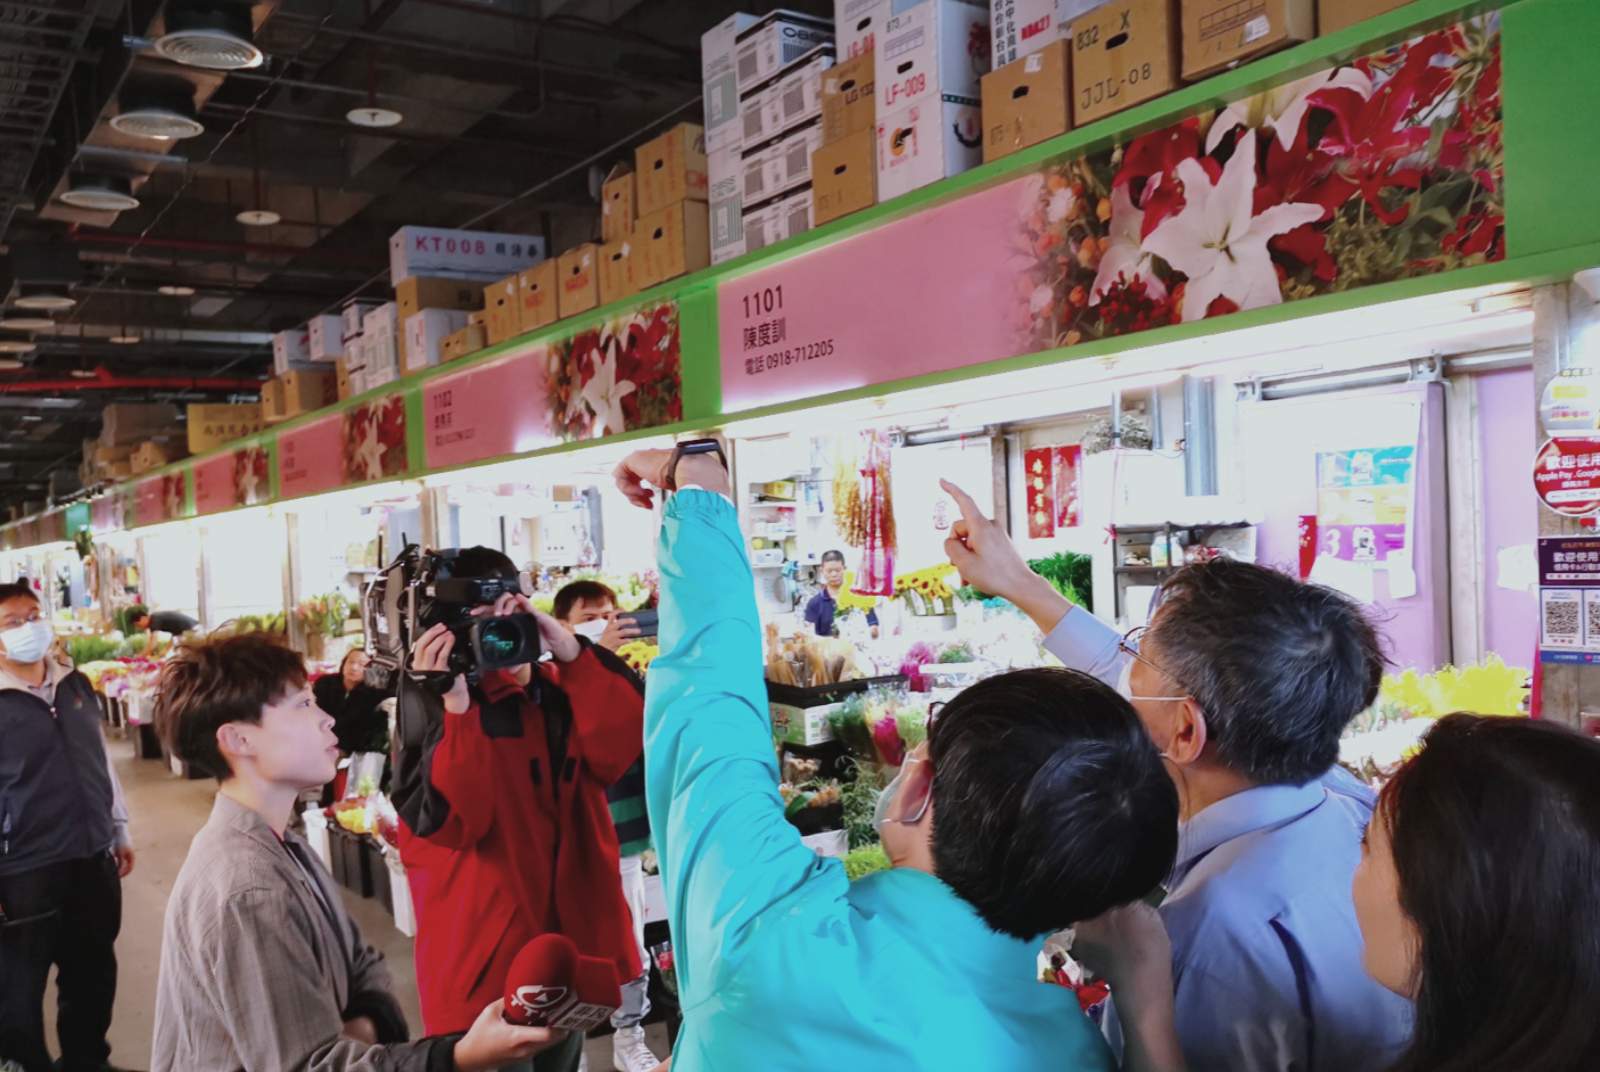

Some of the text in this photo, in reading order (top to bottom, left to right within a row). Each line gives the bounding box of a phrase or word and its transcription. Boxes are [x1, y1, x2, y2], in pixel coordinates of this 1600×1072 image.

[1081, 62, 1152, 110] JJL-08
[415, 235, 486, 255] KT008
[743, 285, 783, 319] 1101
[743, 317, 787, 351] 陳度訓
[766, 339, 834, 370] 0918-712205
